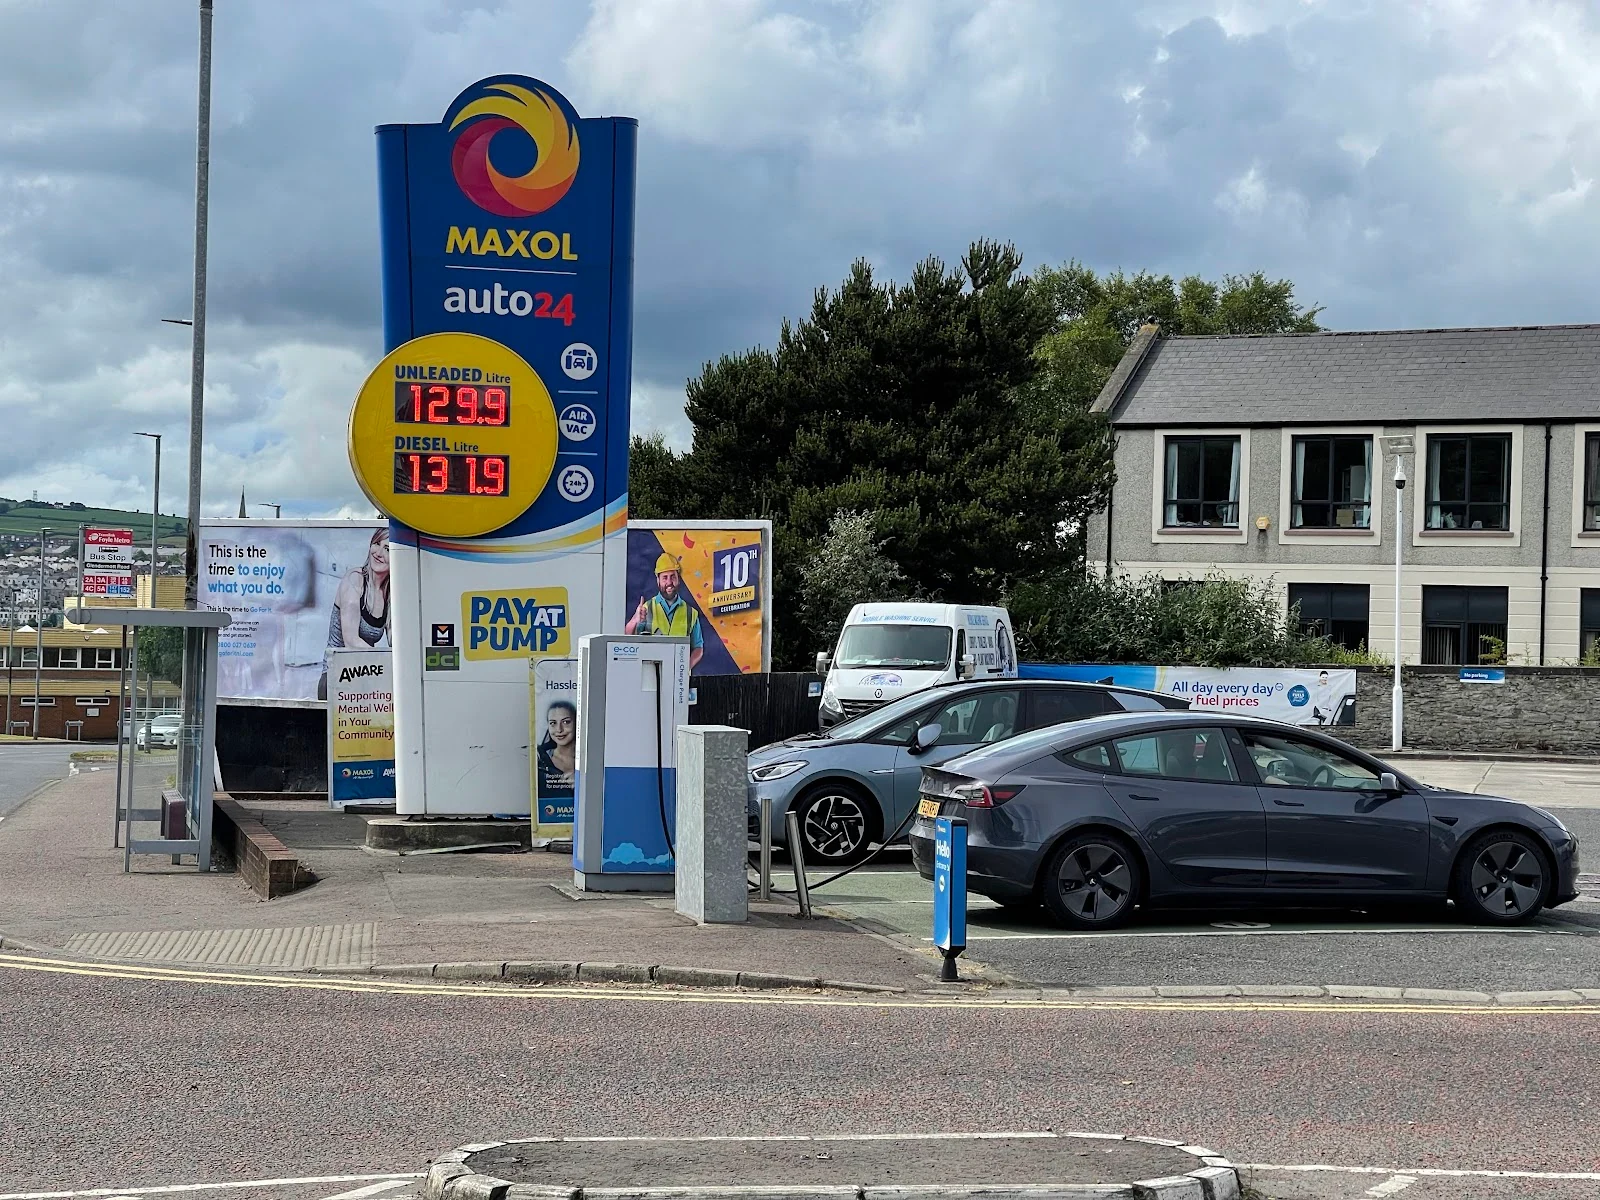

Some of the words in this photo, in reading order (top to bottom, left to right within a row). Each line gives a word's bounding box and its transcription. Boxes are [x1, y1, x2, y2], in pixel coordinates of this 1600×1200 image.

[445, 226, 578, 261] MAXOL
[443, 282, 576, 326] auto24
[395, 365, 482, 382] UNLEADED
[486, 373, 511, 383] Litre
[410, 385, 506, 425] 129.9
[568, 410, 588, 421] AIR
[566, 424, 588, 435] VAC
[395, 436, 450, 452] DIESEL
[454, 442, 479, 453] Litre
[107, 553, 127, 562] Stop
[208, 545, 232, 558] This
[235, 545, 244, 558] is
[246, 545, 267, 558] the
[208, 562, 235, 576] time
[237, 564, 249, 576] to
[252, 563, 285, 580] enjoy
[208, 580, 238, 593] what
[241, 584, 263, 596] you
[265, 581, 285, 594] do.
[712, 590, 752, 604] ANNIVERSARY
[470, 596, 536, 625] PAY
[533, 607, 563, 627] AT
[720, 602, 751, 613] CELEBRATION
[911, 616, 937, 624] SERVICE
[469, 625, 558, 652] PUMP
[425, 651, 459, 667] dci
[338, 664, 384, 682] AWARE
[545, 679, 578, 690] Hassle
[1172, 681, 1188, 692] All
[1191, 681, 1214, 695] day
[1216, 684, 1249, 696] every
[1252, 682, 1274, 697] day
[338, 690, 392, 702] Supporting
[1196, 694, 1219, 706] fuel
[1222, 695, 1259, 709] prices
[338, 703, 372, 714] Mental
[373, 703, 394, 713] Well
[338, 717, 347, 727] in
[349, 717, 372, 727] Your
[338, 728, 394, 741] Community
[936, 839, 950, 858] Hello
